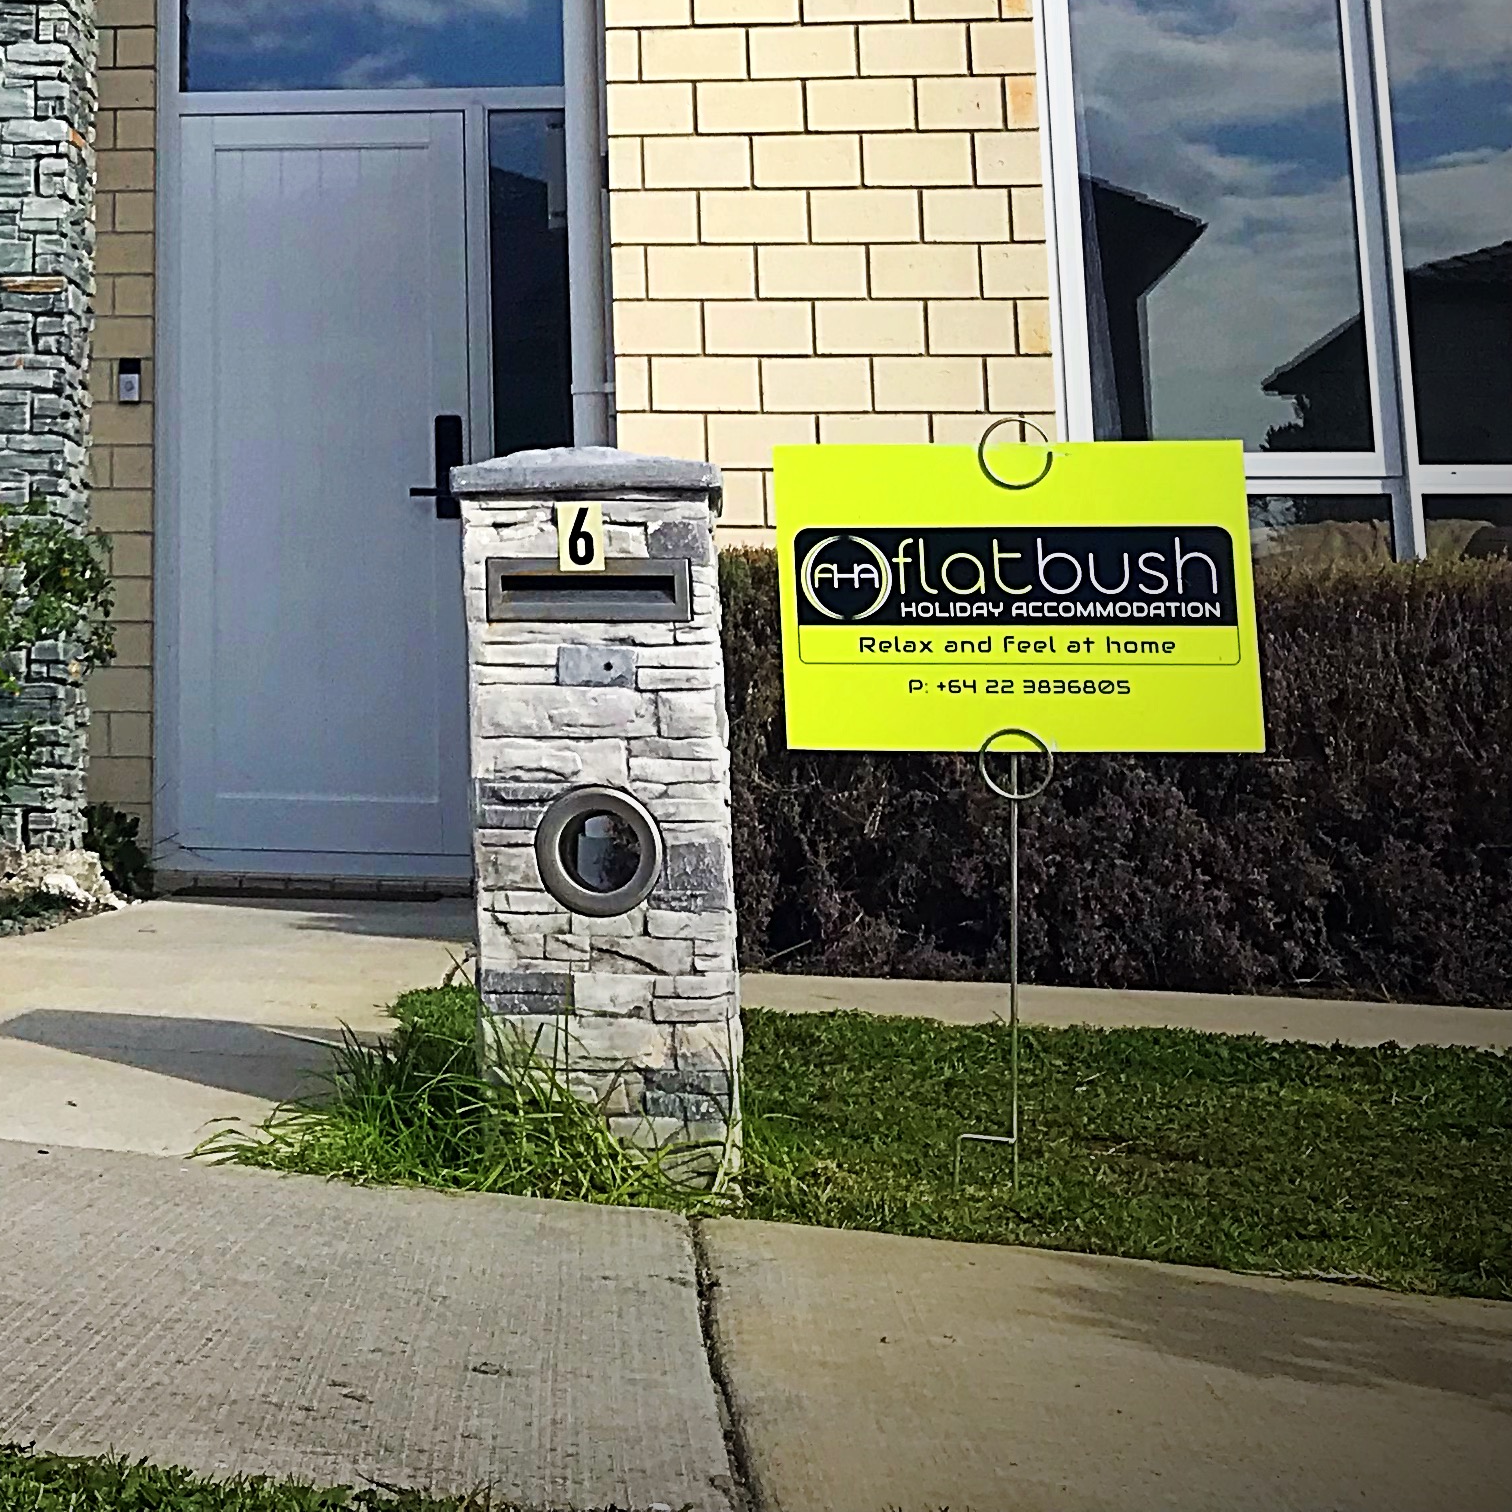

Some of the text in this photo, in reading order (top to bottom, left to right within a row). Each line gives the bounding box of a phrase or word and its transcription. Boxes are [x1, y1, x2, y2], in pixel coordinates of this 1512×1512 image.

[568, 507, 595, 566] 6
[891, 536, 1219, 596] flatbush
[900, 601, 1221, 618] HOLIDAY ACCOMMODATION
[859, 635, 934, 654] Relax
[944, 635, 992, 654] and
[1066, 636, 1096, 654] at
[1106, 635, 1177, 655] home
[908, 679, 1131, 695] P: +64 22 3836805
